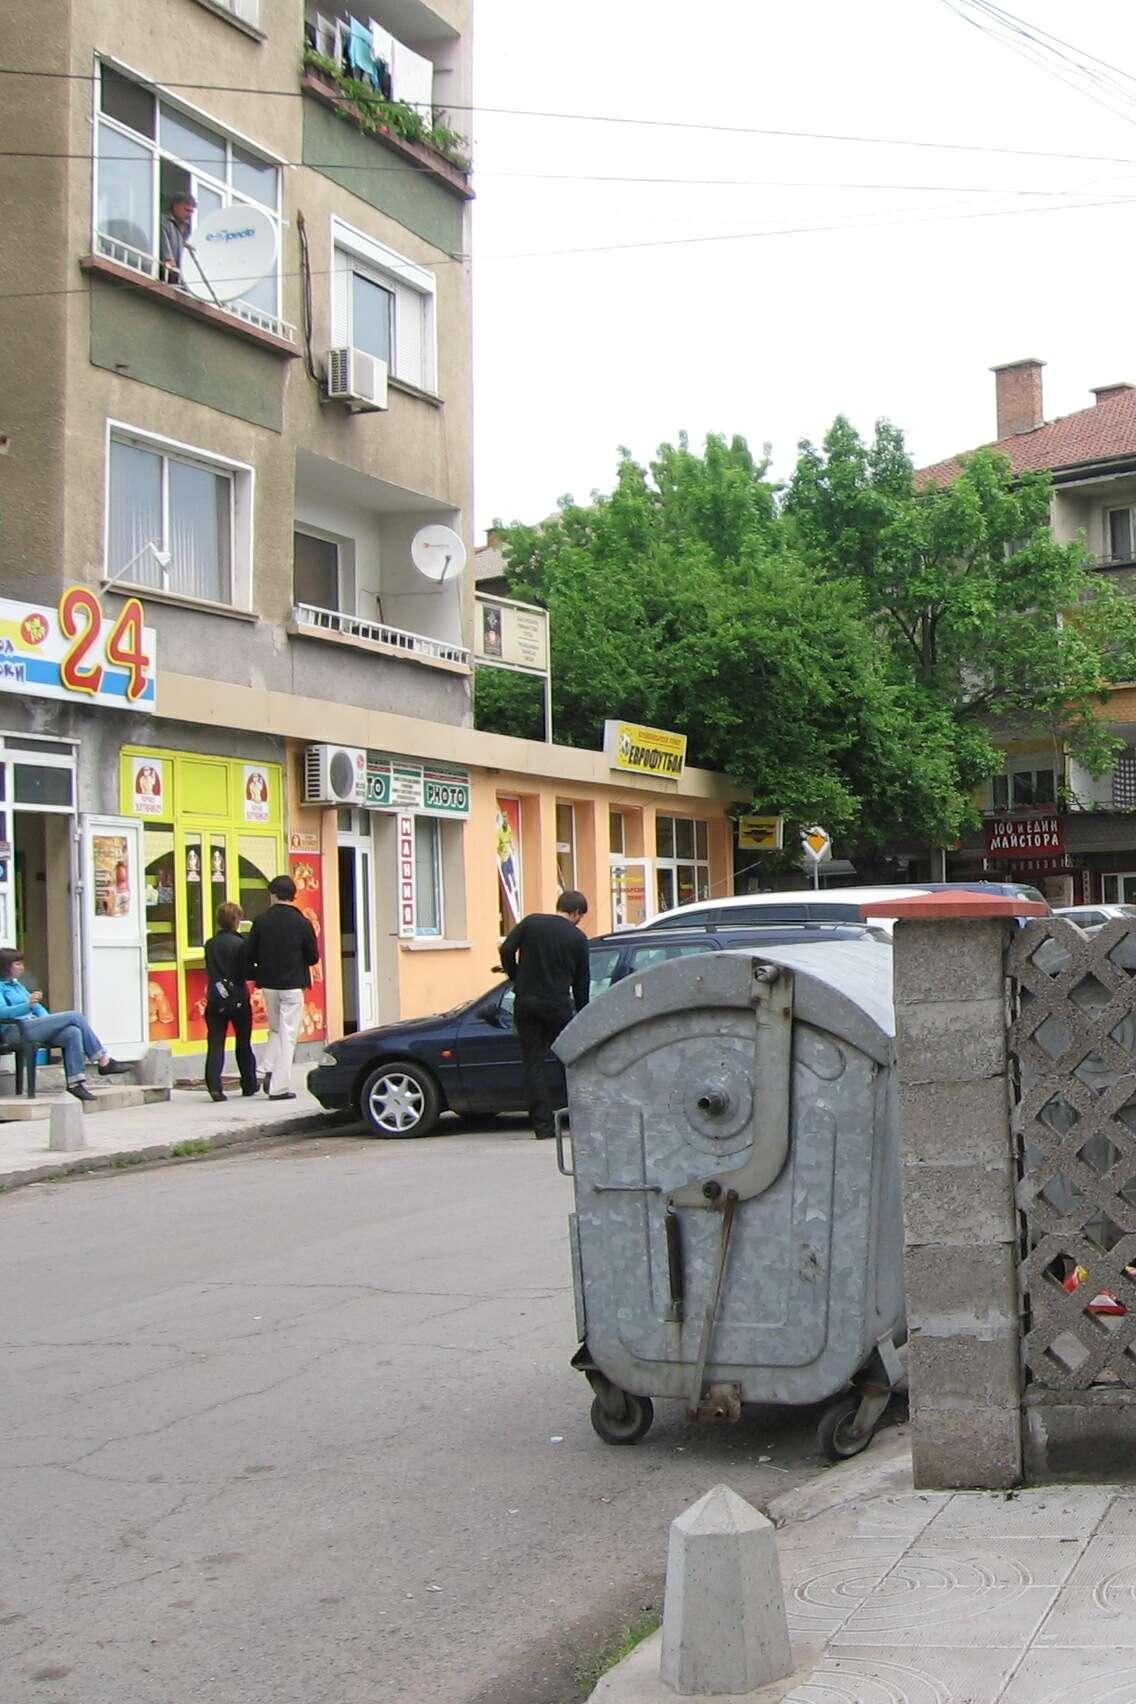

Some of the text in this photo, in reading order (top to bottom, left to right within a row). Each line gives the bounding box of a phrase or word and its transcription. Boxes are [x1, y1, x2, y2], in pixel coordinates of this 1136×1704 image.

[59, 586, 149, 701] 24
[427, 784, 466, 808] PHOTO
[994, 822, 1013, 835] 100
[1026, 819, 1058, 834] ЕДИН
[990, 833, 1059, 850] МАЙСТОРА
